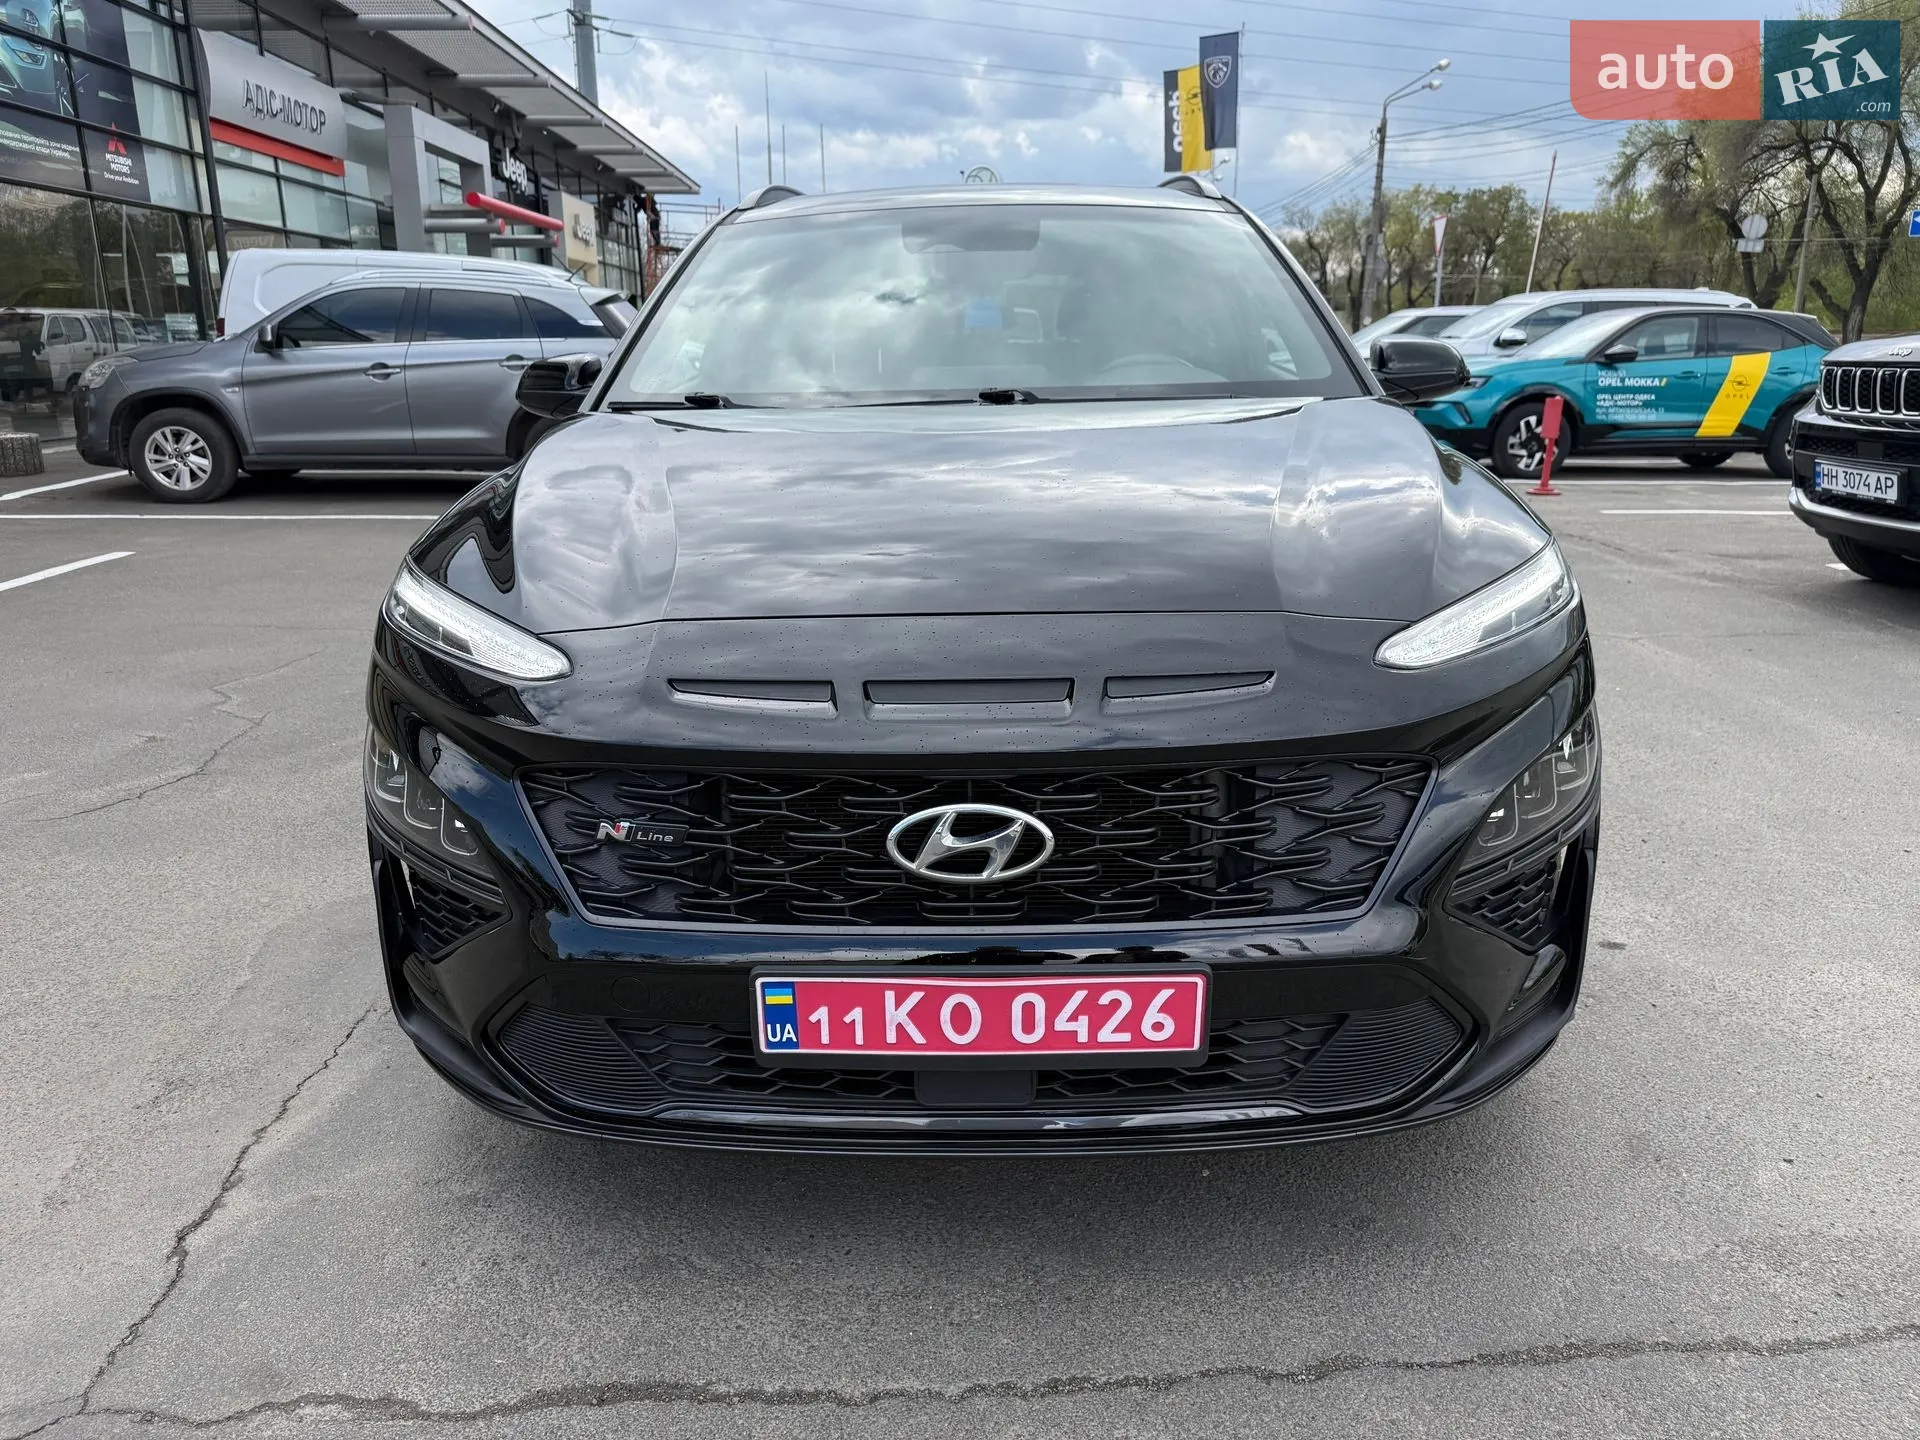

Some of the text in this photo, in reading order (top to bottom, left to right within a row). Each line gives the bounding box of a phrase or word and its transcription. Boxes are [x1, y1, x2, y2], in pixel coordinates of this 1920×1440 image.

[242, 79, 326, 135] АДІС-МОТОР
[105, 153, 132, 166] MITSUBISHI
[110, 162, 131, 174] MOTORS
[103, 172, 115, 180] Drive
[502, 147, 528, 192] Jeep
[1598, 377, 1660, 387] OPEL MOKKA
[1613, 394, 1633, 402] ЦЕНТР
[1822, 466, 1895, 495] HH 3074 AP
[597, 821, 674, 842] N Line
[1010, 989, 1177, 1046] 0426
[767, 1025, 797, 1042] UA
